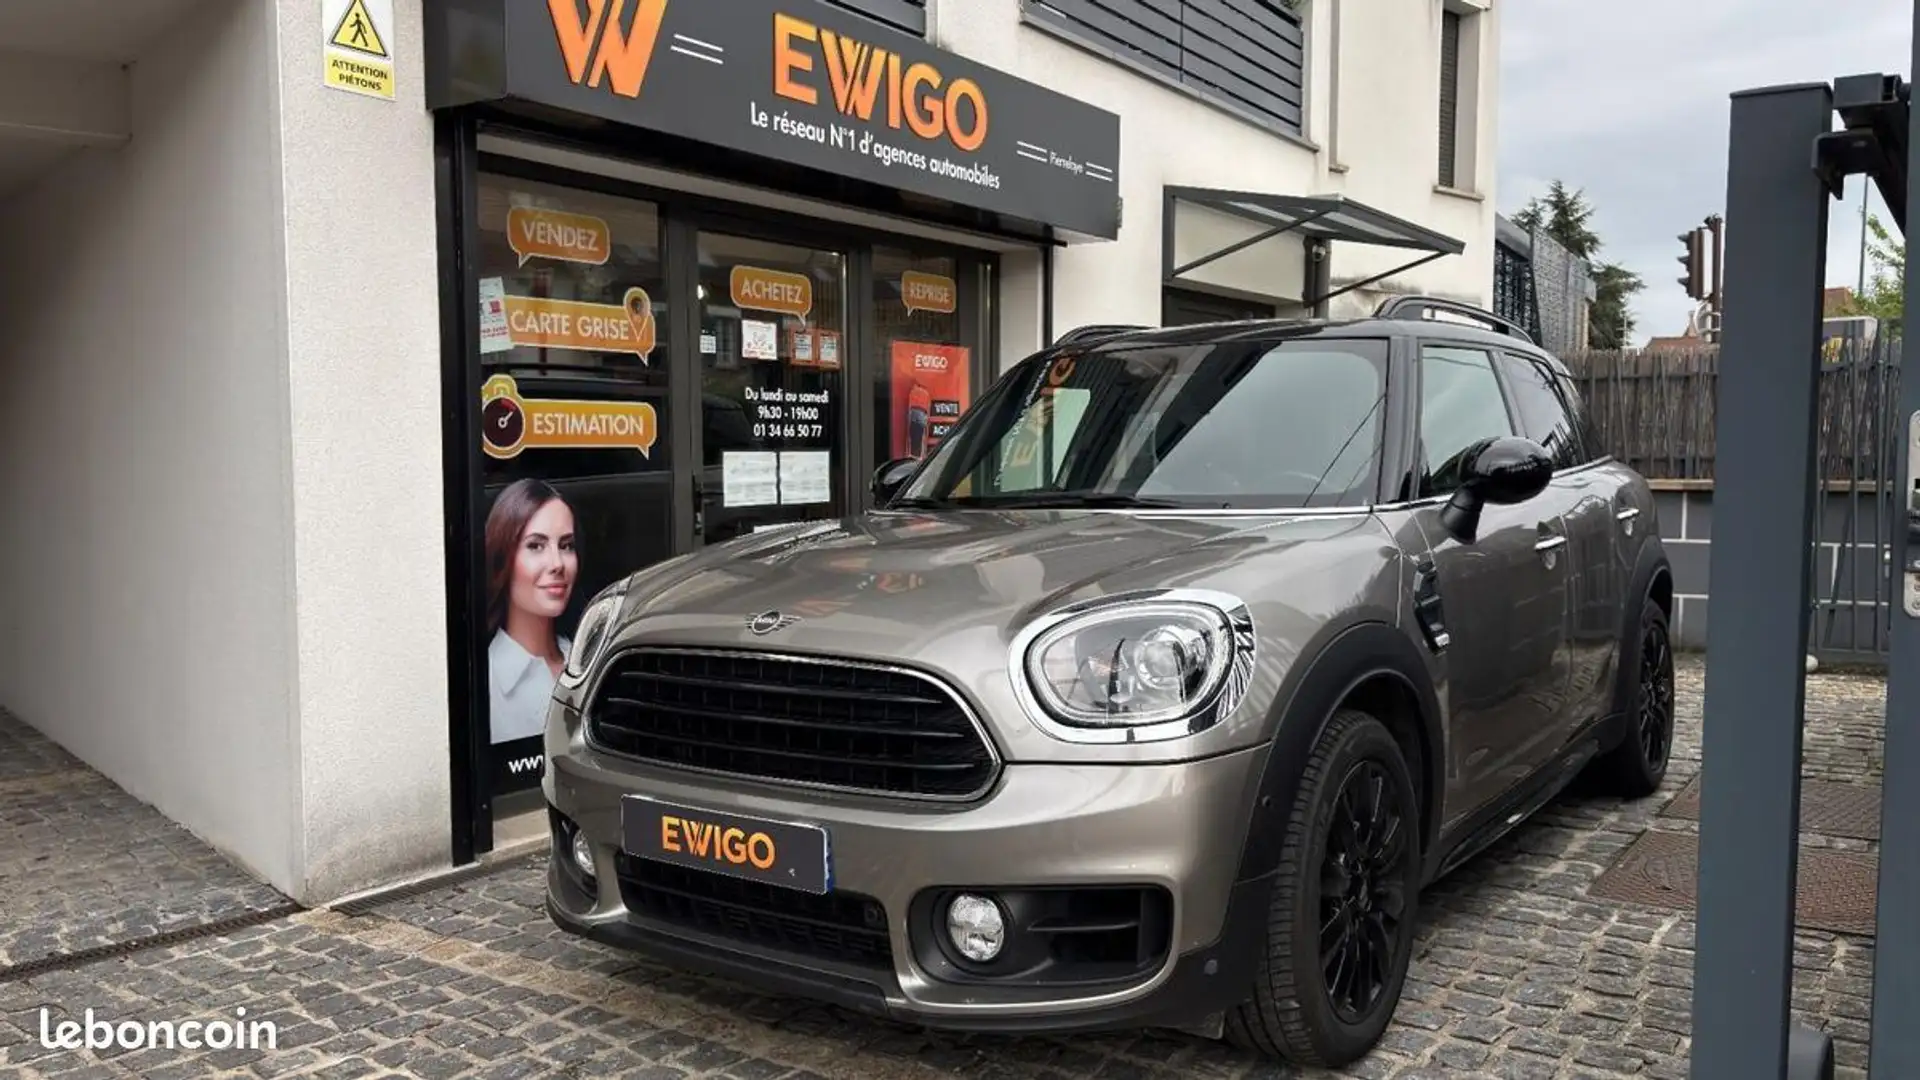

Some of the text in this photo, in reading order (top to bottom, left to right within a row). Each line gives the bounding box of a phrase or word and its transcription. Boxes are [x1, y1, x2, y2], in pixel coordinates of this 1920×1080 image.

[331, 59, 388, 80] ATTENTION
[338, 73, 382, 91] PIÉTONS
[773, 12, 988, 151] EWIGO
[750, 101, 768, 128] Le
[773, 109, 825, 143] réseau
[859, 130, 926, 170] d'agences
[929, 156, 1000, 189] automobiles
[521, 219, 599, 252] VENDEZ
[740, 276, 804, 304] ACHETEZ
[908, 281, 950, 305] REPRISE
[510, 311, 571, 336] CARTE
[576, 316, 630, 341] GRISE
[914, 354, 948, 369] EWIGO
[745, 387, 829, 403] Du lundi au samedi
[757, 405, 782, 419] 9h30
[790, 406, 819, 420] 19h00
[533, 413, 644, 436] ESTIMATION
[753, 423, 823, 438] 01 34 66 50 77
[662, 815, 776, 869] EWIGO
